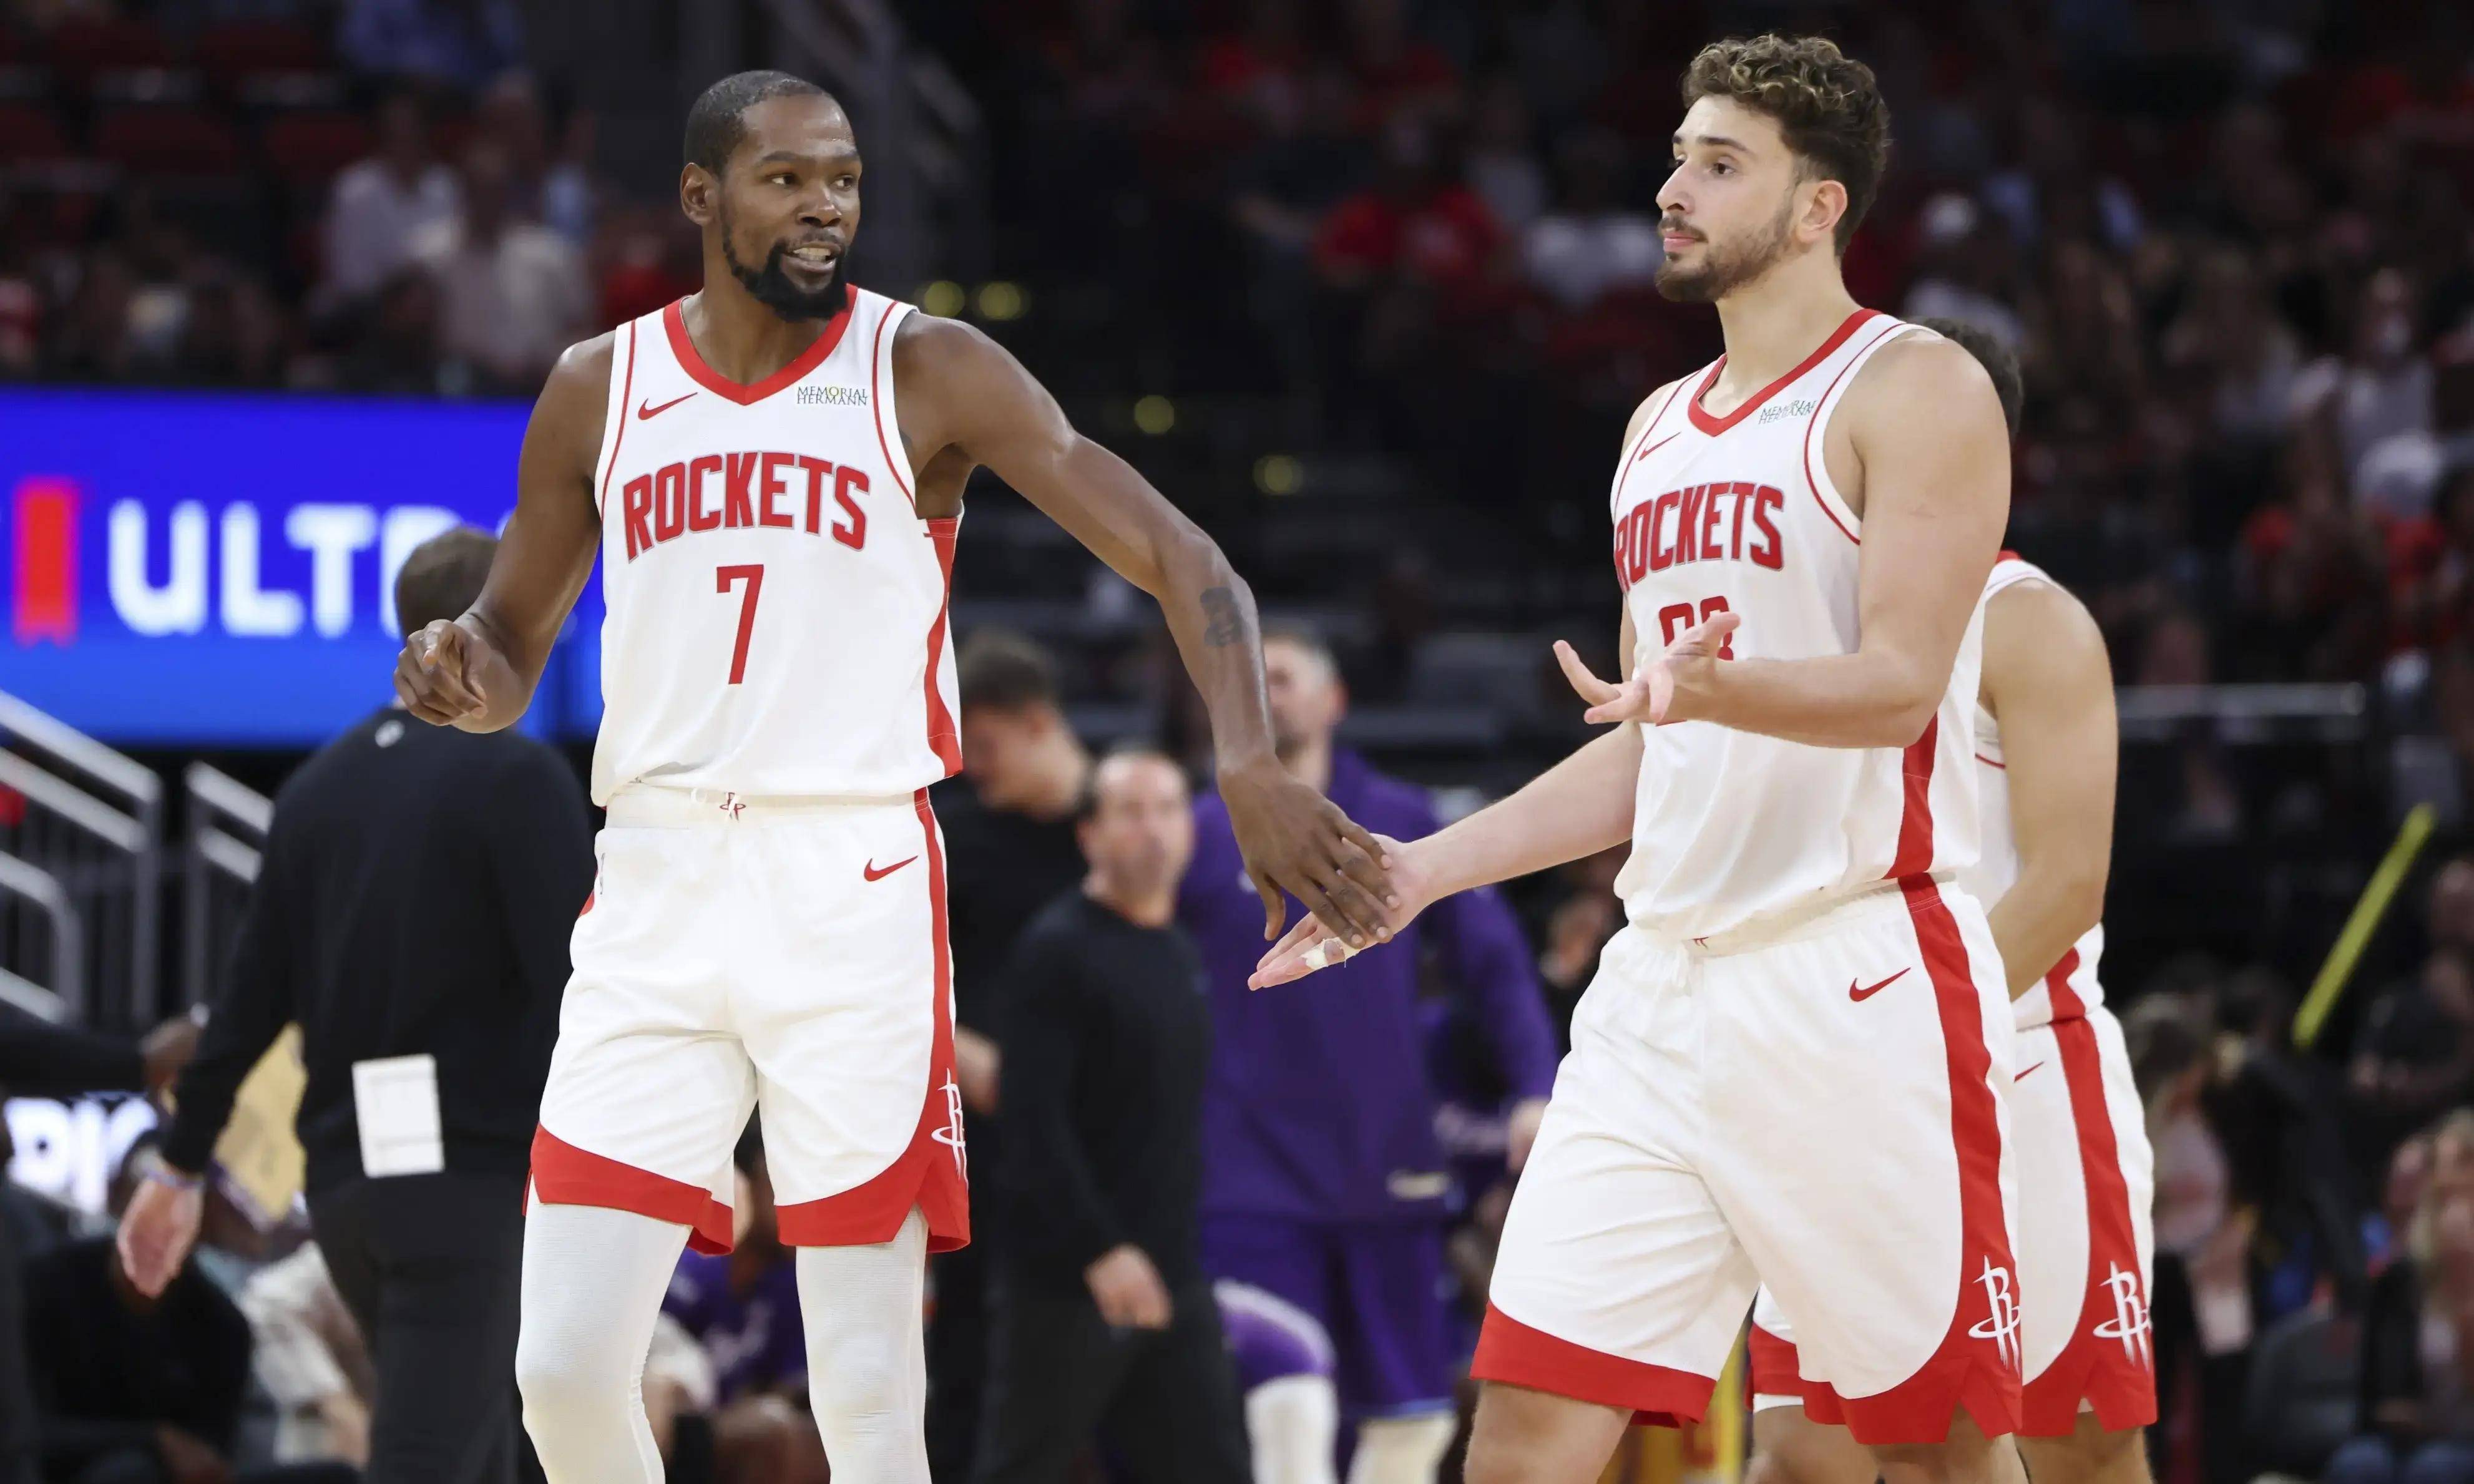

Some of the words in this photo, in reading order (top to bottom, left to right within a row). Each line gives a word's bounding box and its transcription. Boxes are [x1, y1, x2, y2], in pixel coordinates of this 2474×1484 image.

[796, 394, 867, 406] HERMANN
[797, 386, 868, 398] MEMORIAL
[623, 450, 871, 565] ROCKETS
[1614, 480, 1784, 594] ROCKETS
[107, 497, 521, 638] ULT
[716, 564, 765, 685] 7
